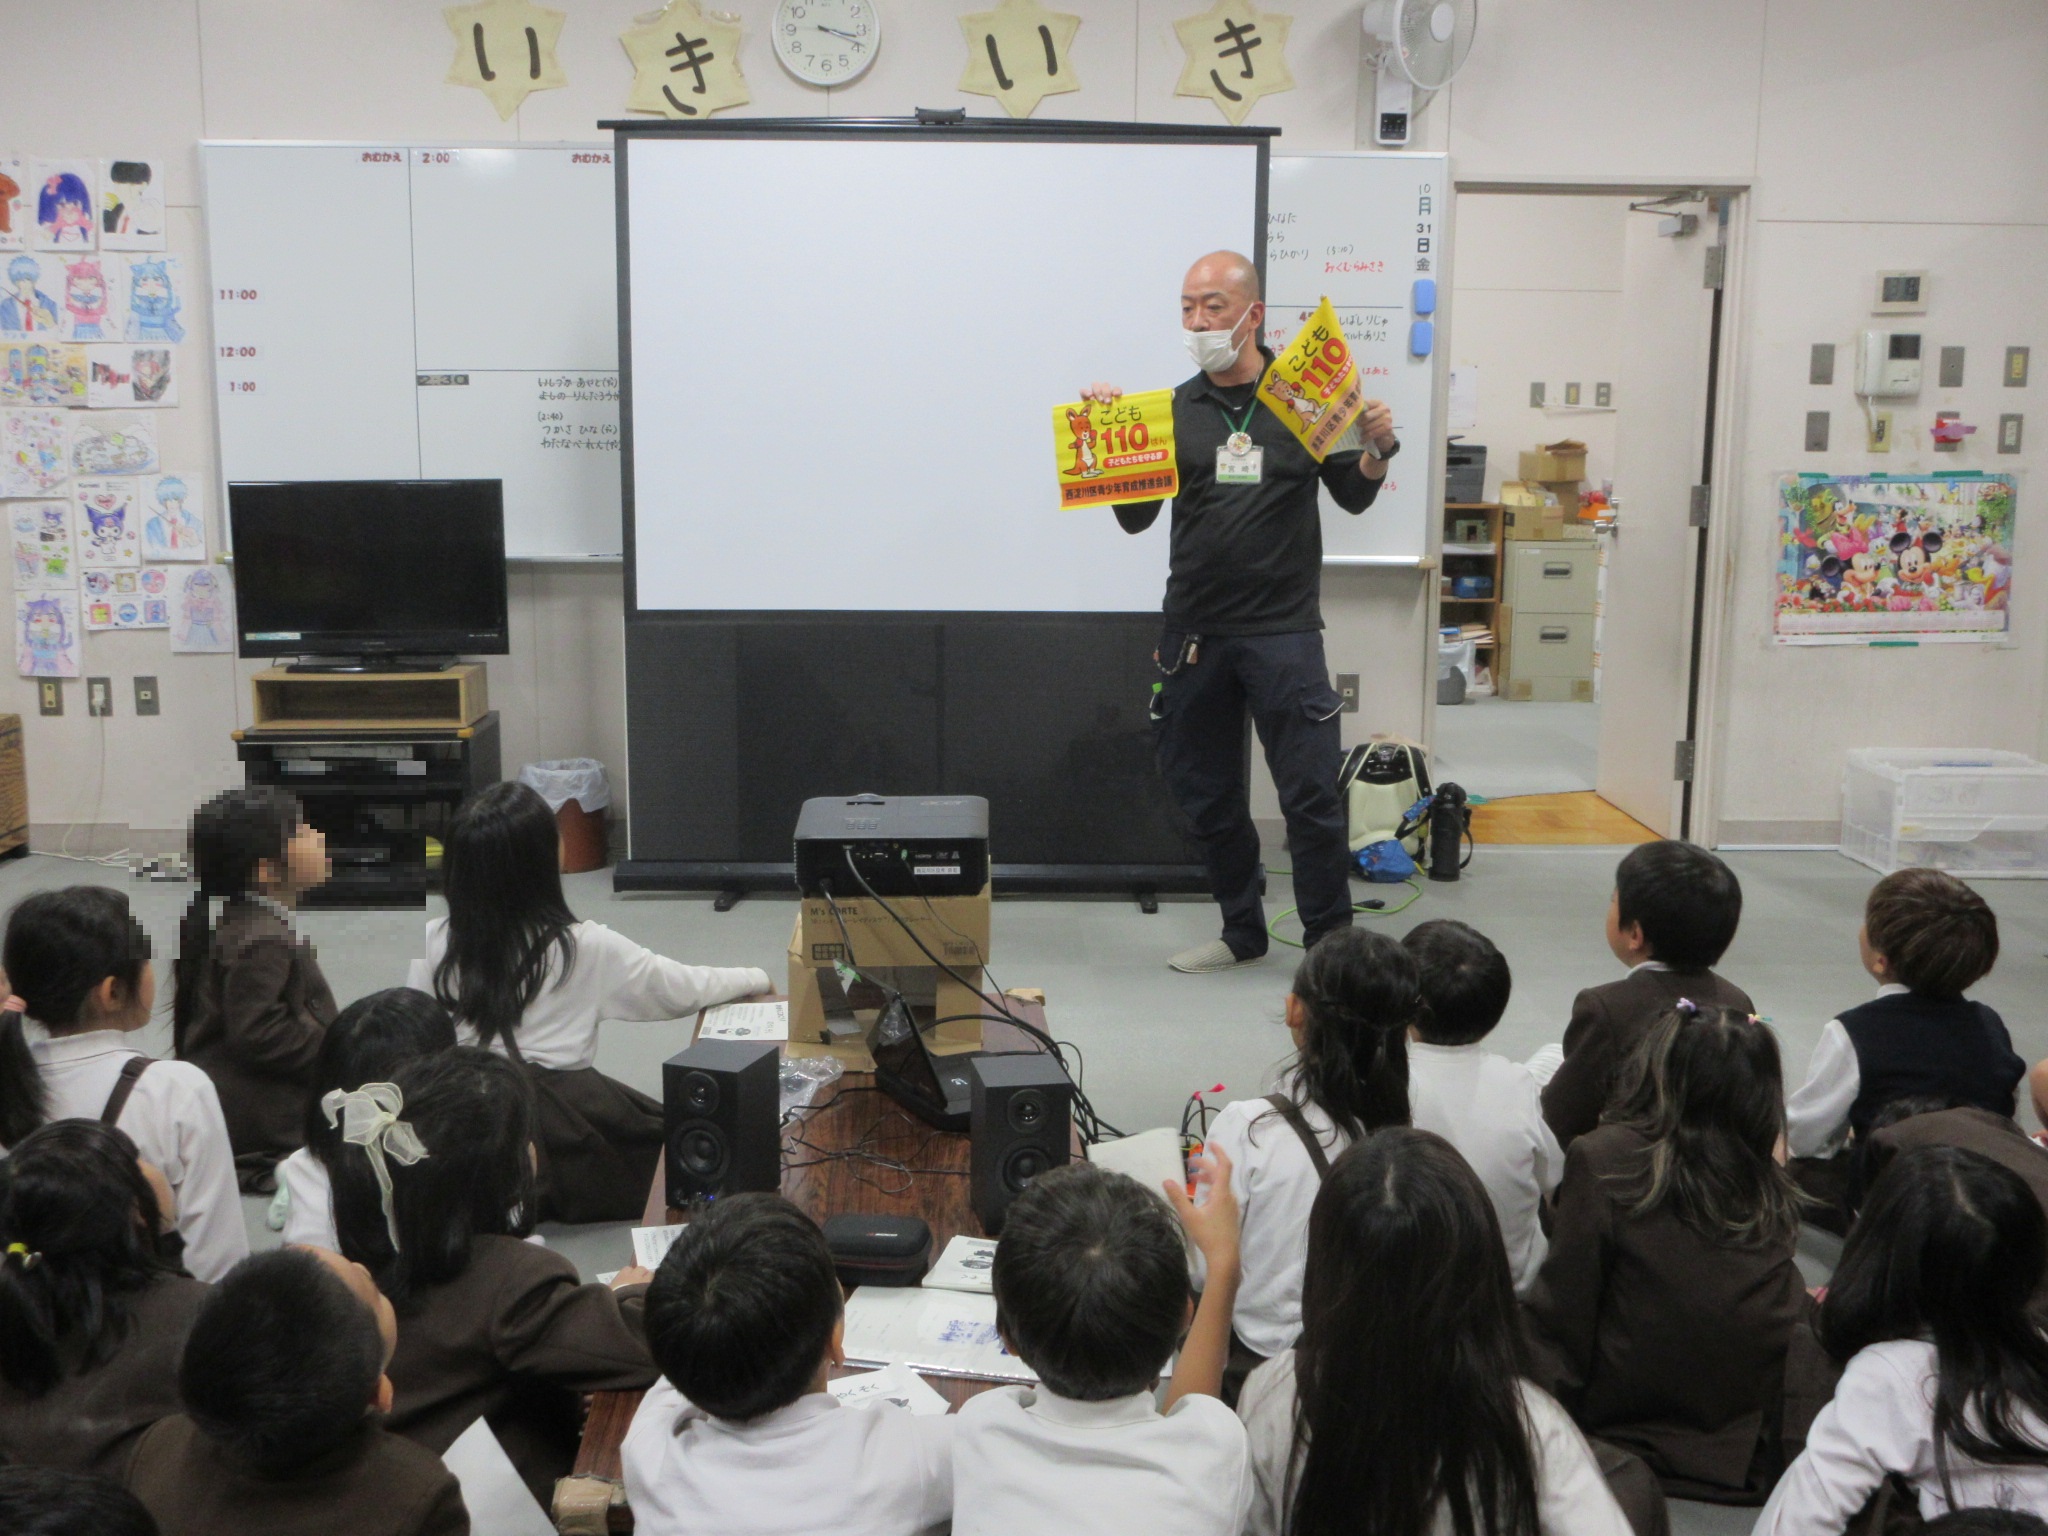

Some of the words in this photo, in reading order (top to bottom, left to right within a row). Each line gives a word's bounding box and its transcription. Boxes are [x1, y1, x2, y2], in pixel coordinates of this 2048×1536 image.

[791, 6, 806, 19] 10
[850, 5, 861, 18] 2
[785, 24, 797, 36] 9
[856, 24, 867, 36] 3
[791, 41, 802, 53] 8
[473, 22, 541, 81] い
[662, 32, 714, 115] き
[985, 25, 1058, 90] い
[1211, 18, 1262, 101] き
[805, 54, 815, 67] 7
[821, 59, 832, 72] 6
[838, 54, 849, 67] 5
[361, 152, 402, 163] おむかえ
[422, 153, 450, 164] 2:00
[571, 153, 612, 164] おむかえ
[220, 289, 257, 300] 11:00
[220, 346, 257, 357] 12:00
[1288, 325, 1330, 373] こども
[1300, 337, 1347, 388] 110
[230, 382, 256, 392] 1:00
[417, 375, 467, 386] 2:30
[1100, 405, 1142, 426] こども
[1101, 422, 1149, 455] 110
[1108, 451, 1163, 467] 子どもたちを守る家
